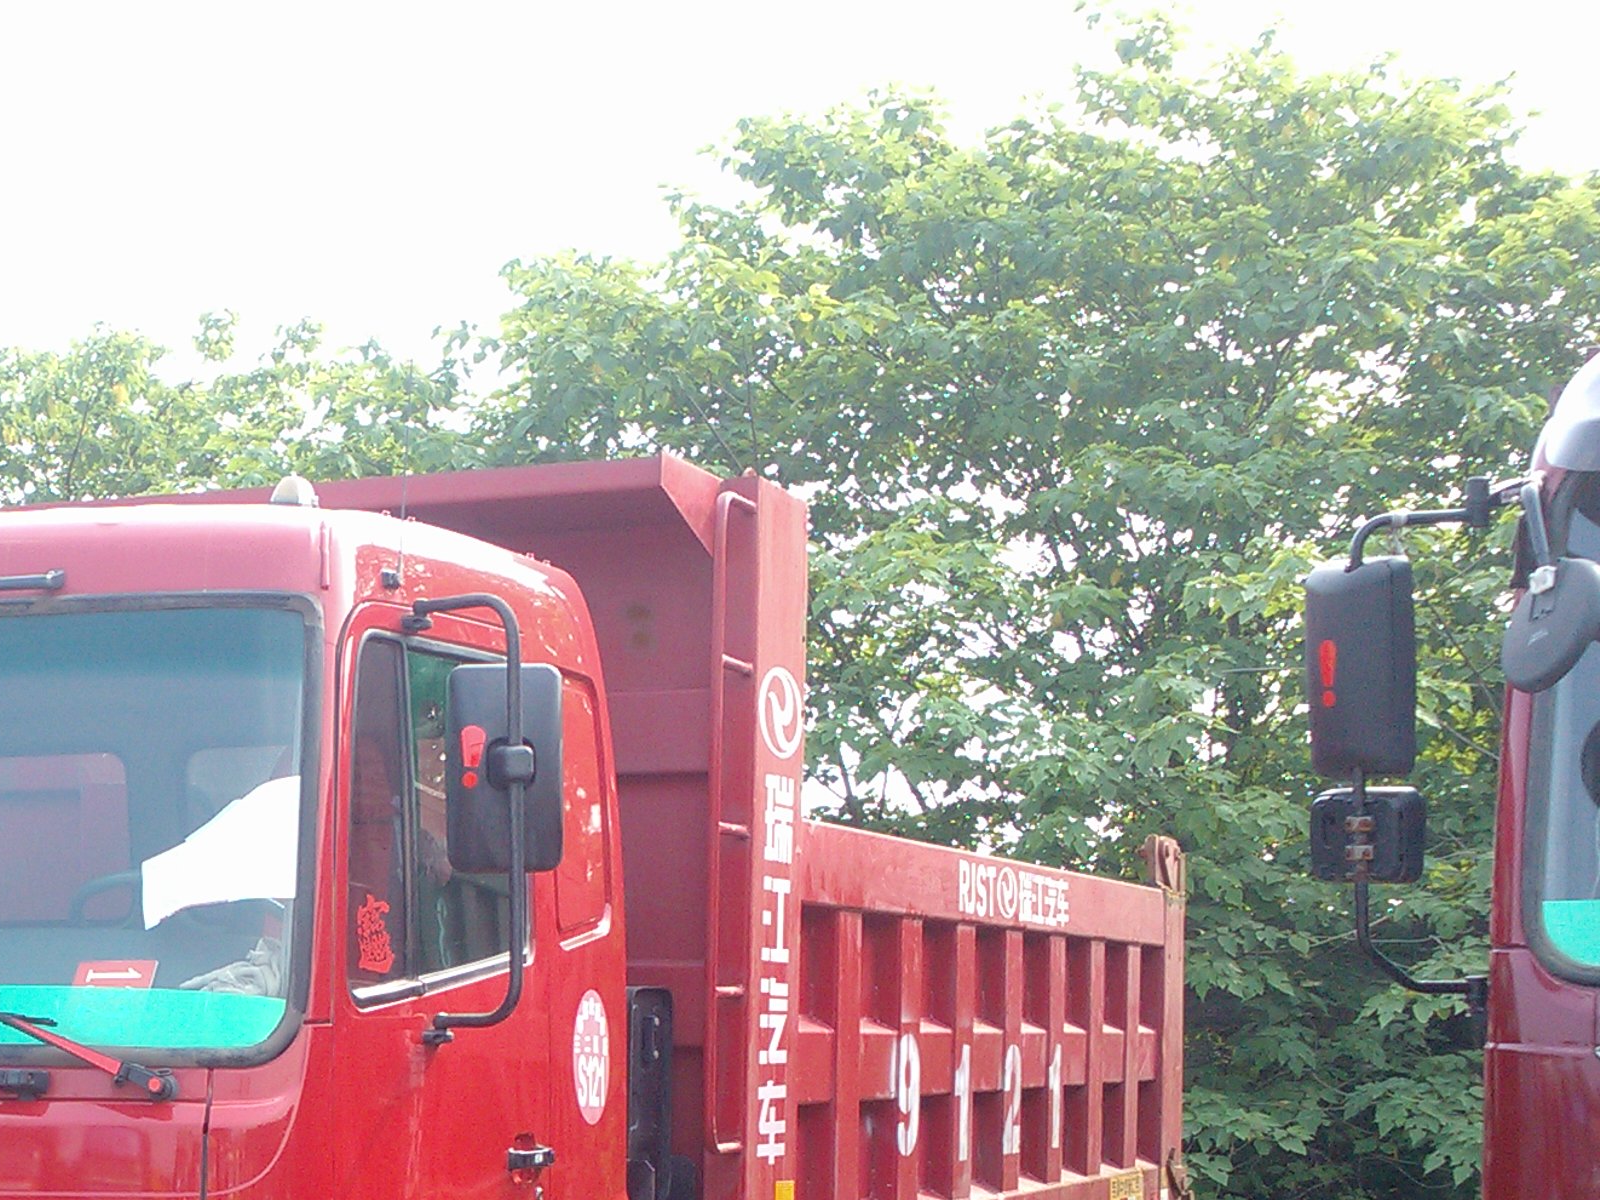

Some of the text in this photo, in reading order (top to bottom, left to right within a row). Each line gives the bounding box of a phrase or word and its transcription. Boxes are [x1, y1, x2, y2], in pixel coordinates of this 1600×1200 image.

[958, 858, 1070, 927] RJST 瑞江汽车
[756, 773, 795, 1165] 瑞江汽车
[897, 1033, 1062, 1162] 9121
